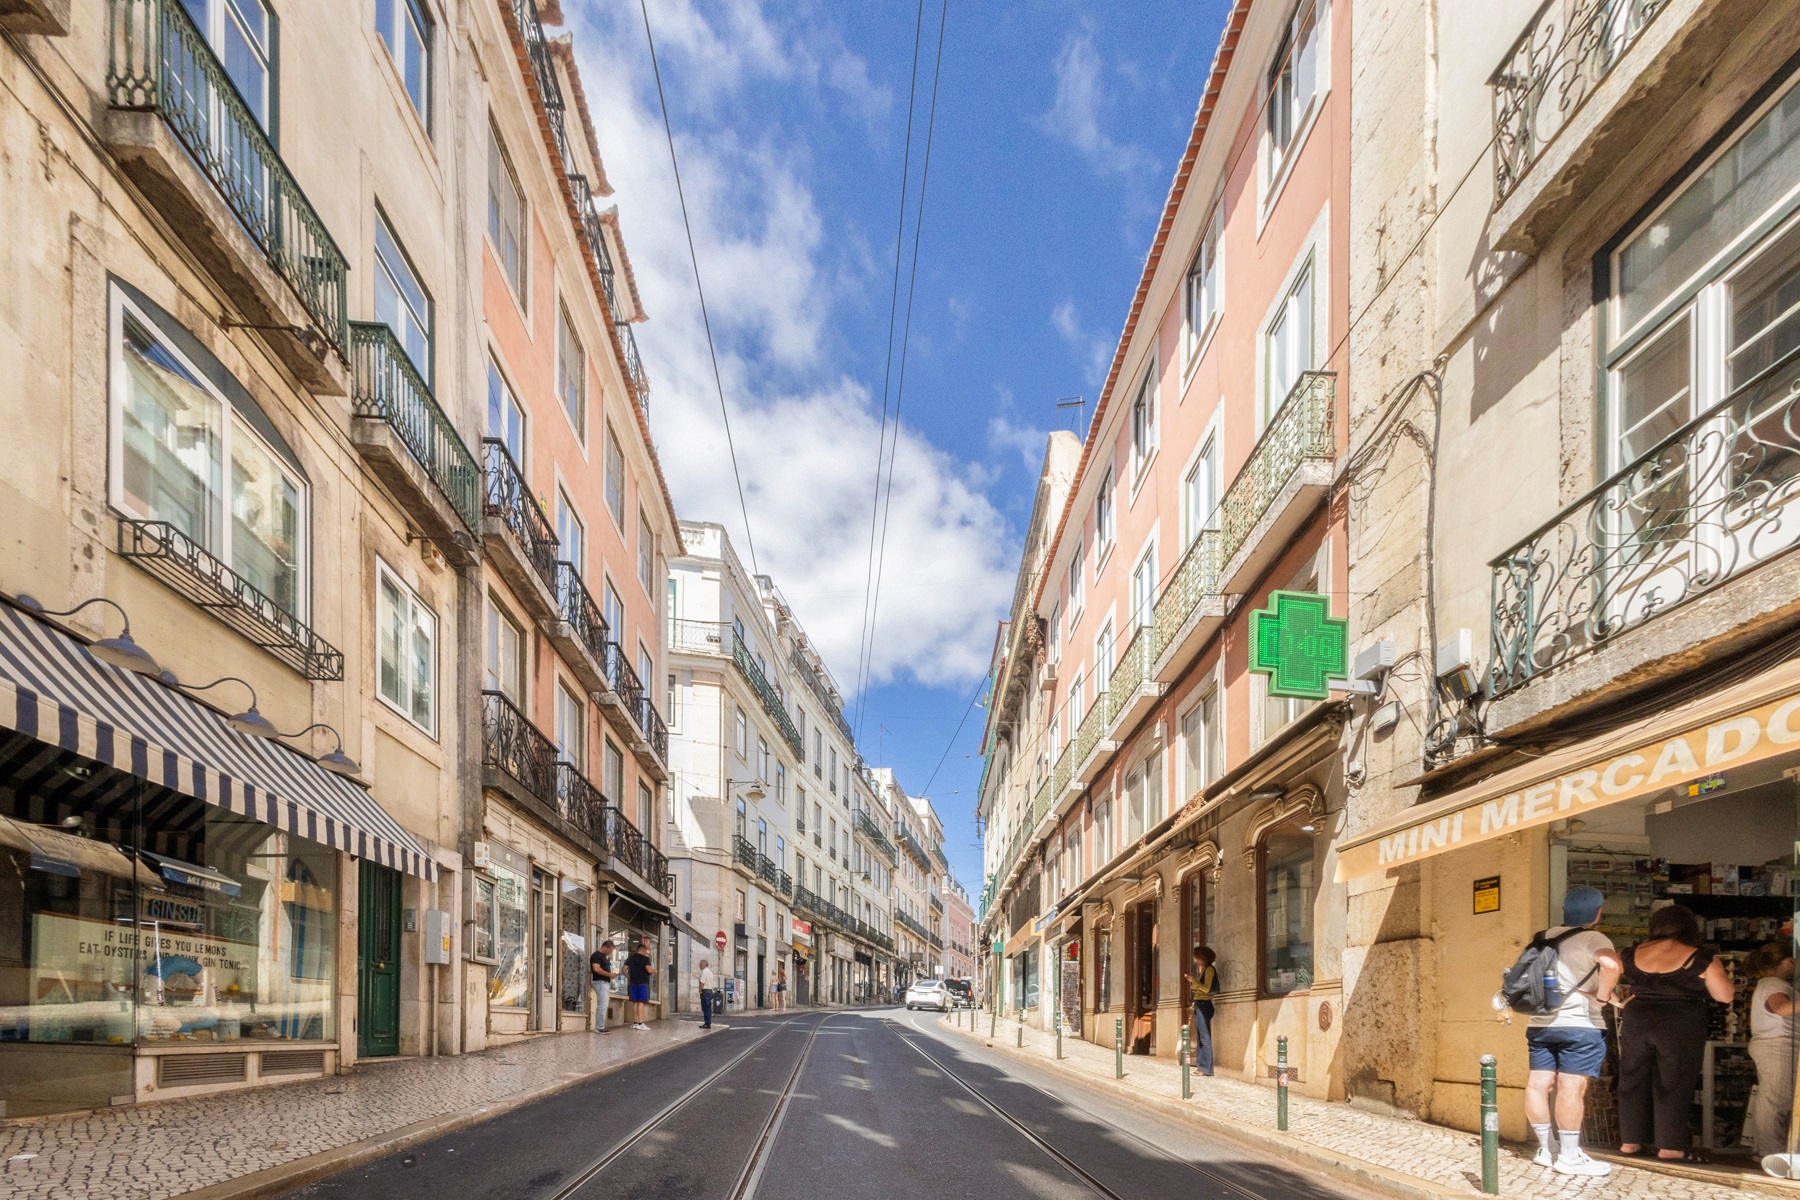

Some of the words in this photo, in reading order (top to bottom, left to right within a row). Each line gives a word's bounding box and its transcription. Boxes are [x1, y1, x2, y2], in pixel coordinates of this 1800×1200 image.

[1378, 812, 1464, 866] MINI
[151, 899, 176, 920] GIN
[79, 942, 100, 954] EAT
[203, 957, 216, 968] GIN
[104, 930, 114, 942] IF
[119, 932, 139, 946] LIFE
[145, 936, 171, 950] GIES
[175, 940, 191, 952] YOU
[195, 943, 227, 957] LEMONS
